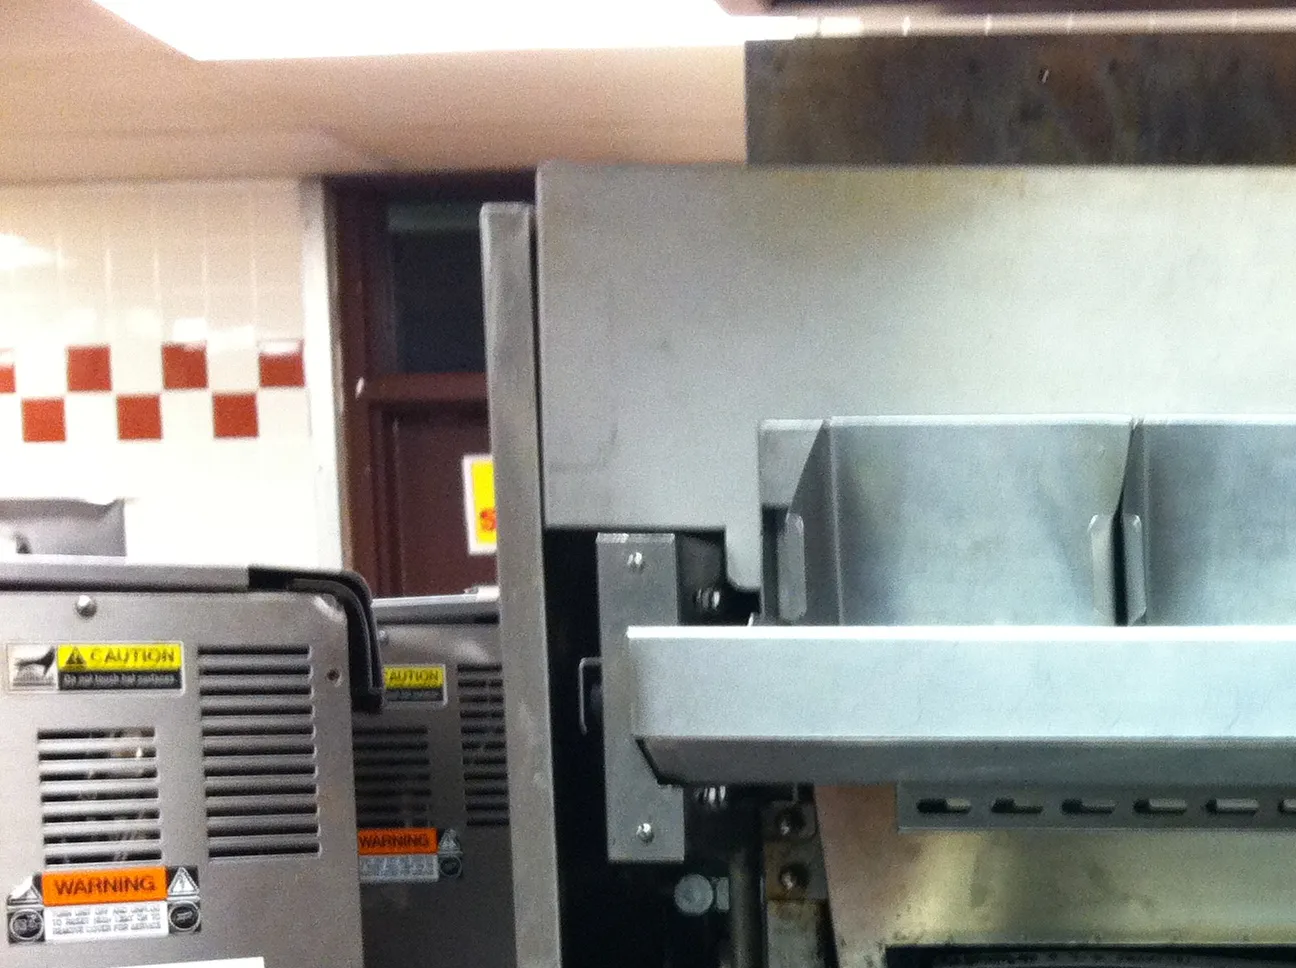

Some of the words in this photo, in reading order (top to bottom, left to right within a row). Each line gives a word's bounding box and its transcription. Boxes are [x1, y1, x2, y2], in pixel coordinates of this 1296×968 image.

[90, 647, 175, 664] CAUTION
[385, 669, 439, 682] AUTION
[54, 874, 157, 896] WARNING
